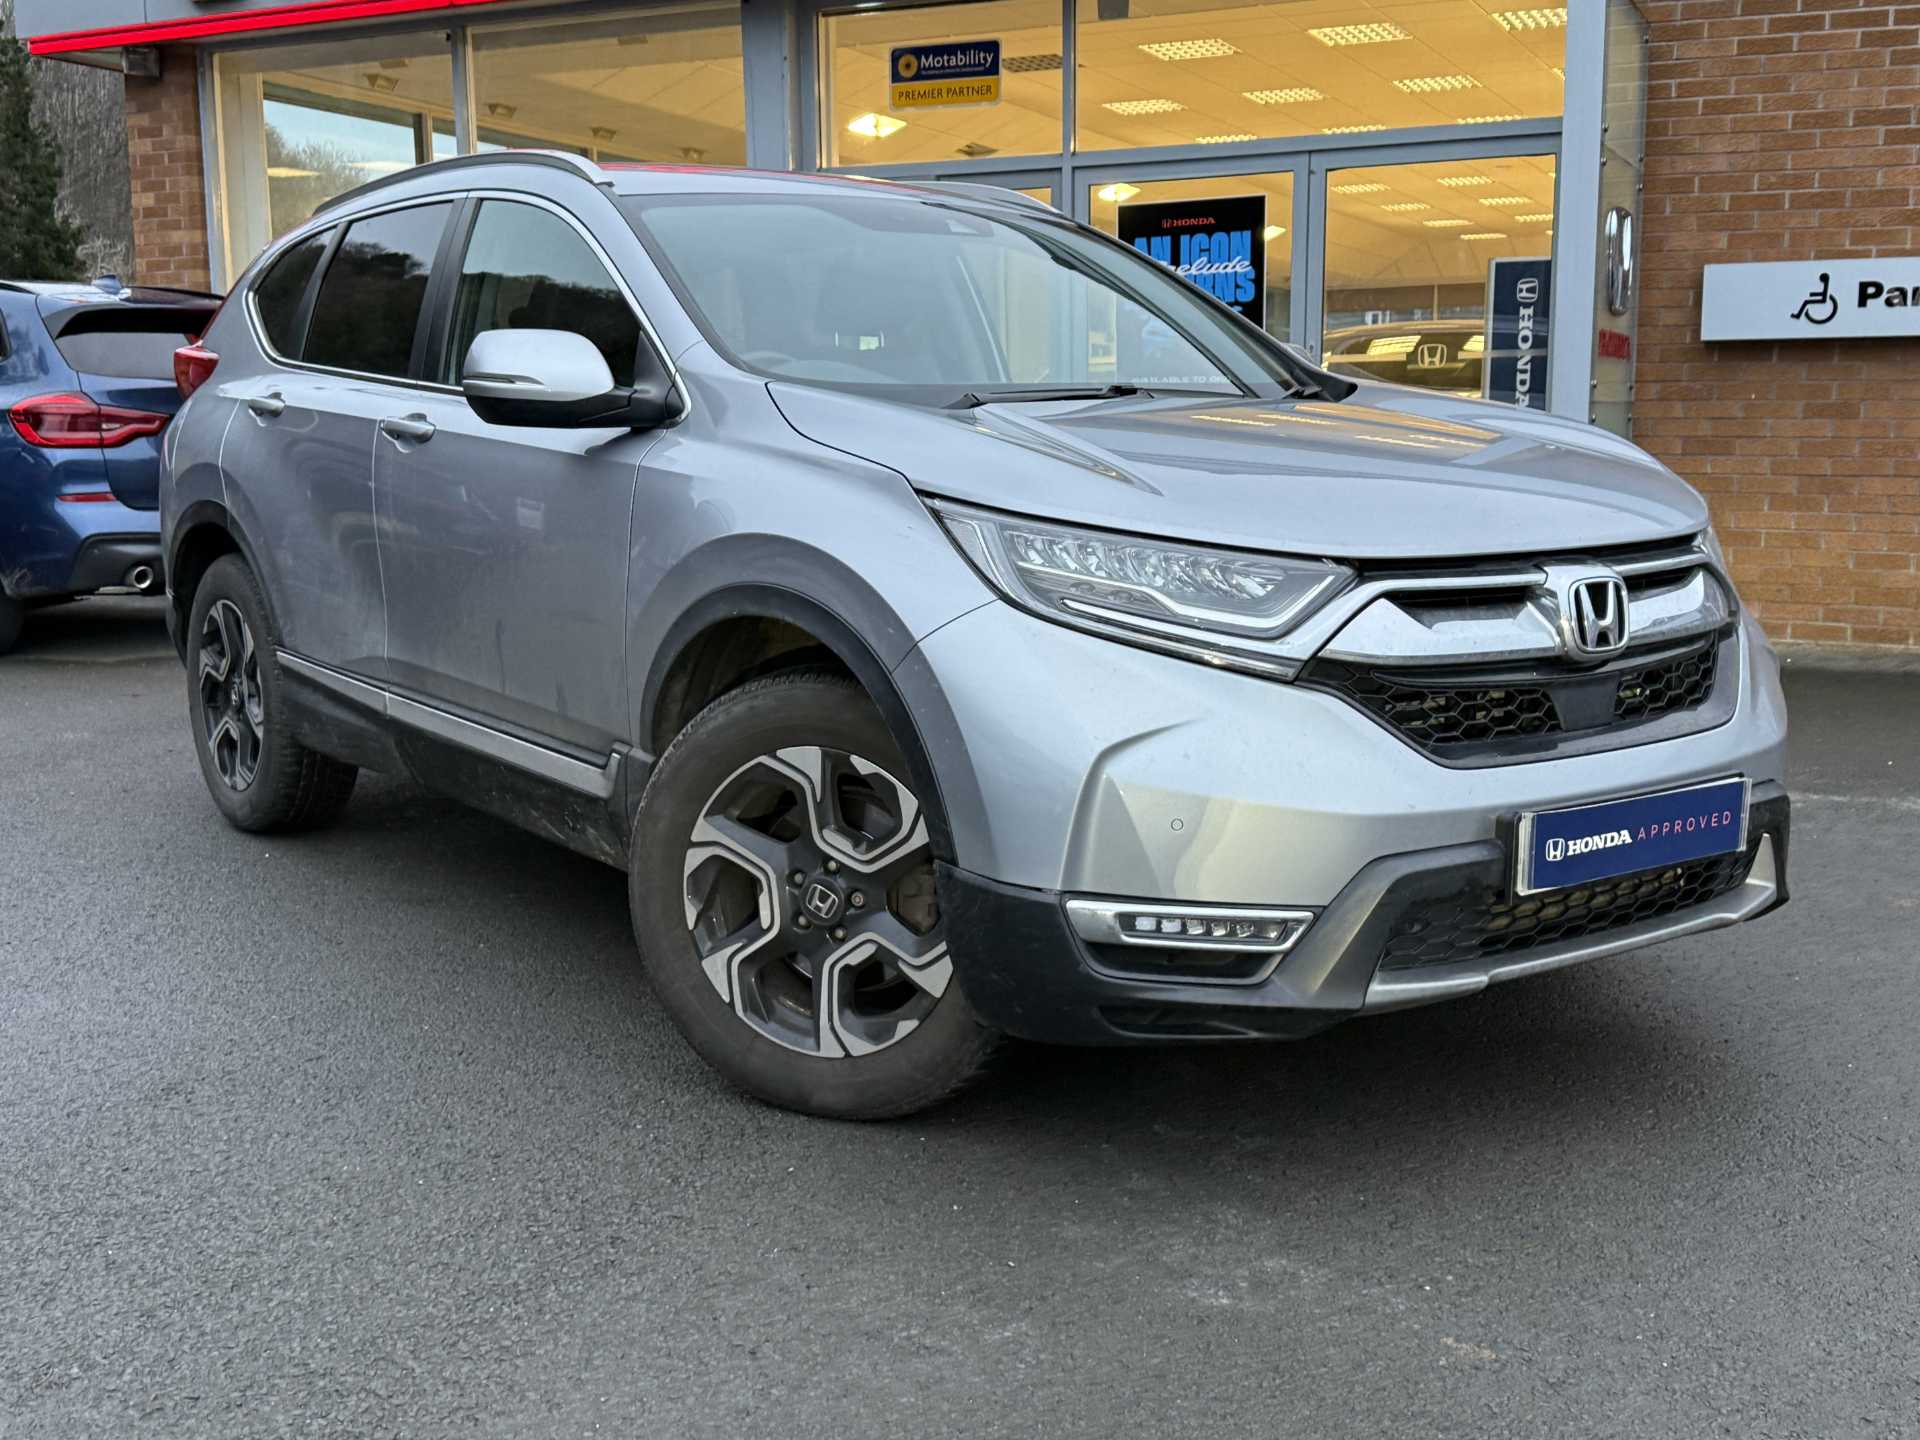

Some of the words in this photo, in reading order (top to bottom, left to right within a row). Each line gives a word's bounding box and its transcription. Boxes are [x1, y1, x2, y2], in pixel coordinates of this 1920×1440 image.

[920, 49, 994, 68] Motability
[898, 88, 943, 101] PREMIER
[946, 84, 992, 98] PARTNER
[1173, 217, 1216, 227] HONDA
[1180, 230, 1252, 265] ICON
[1515, 306, 1534, 408] HONDA
[1566, 829, 1633, 856] HONDA
[1637, 811, 1732, 841] APPROVED
